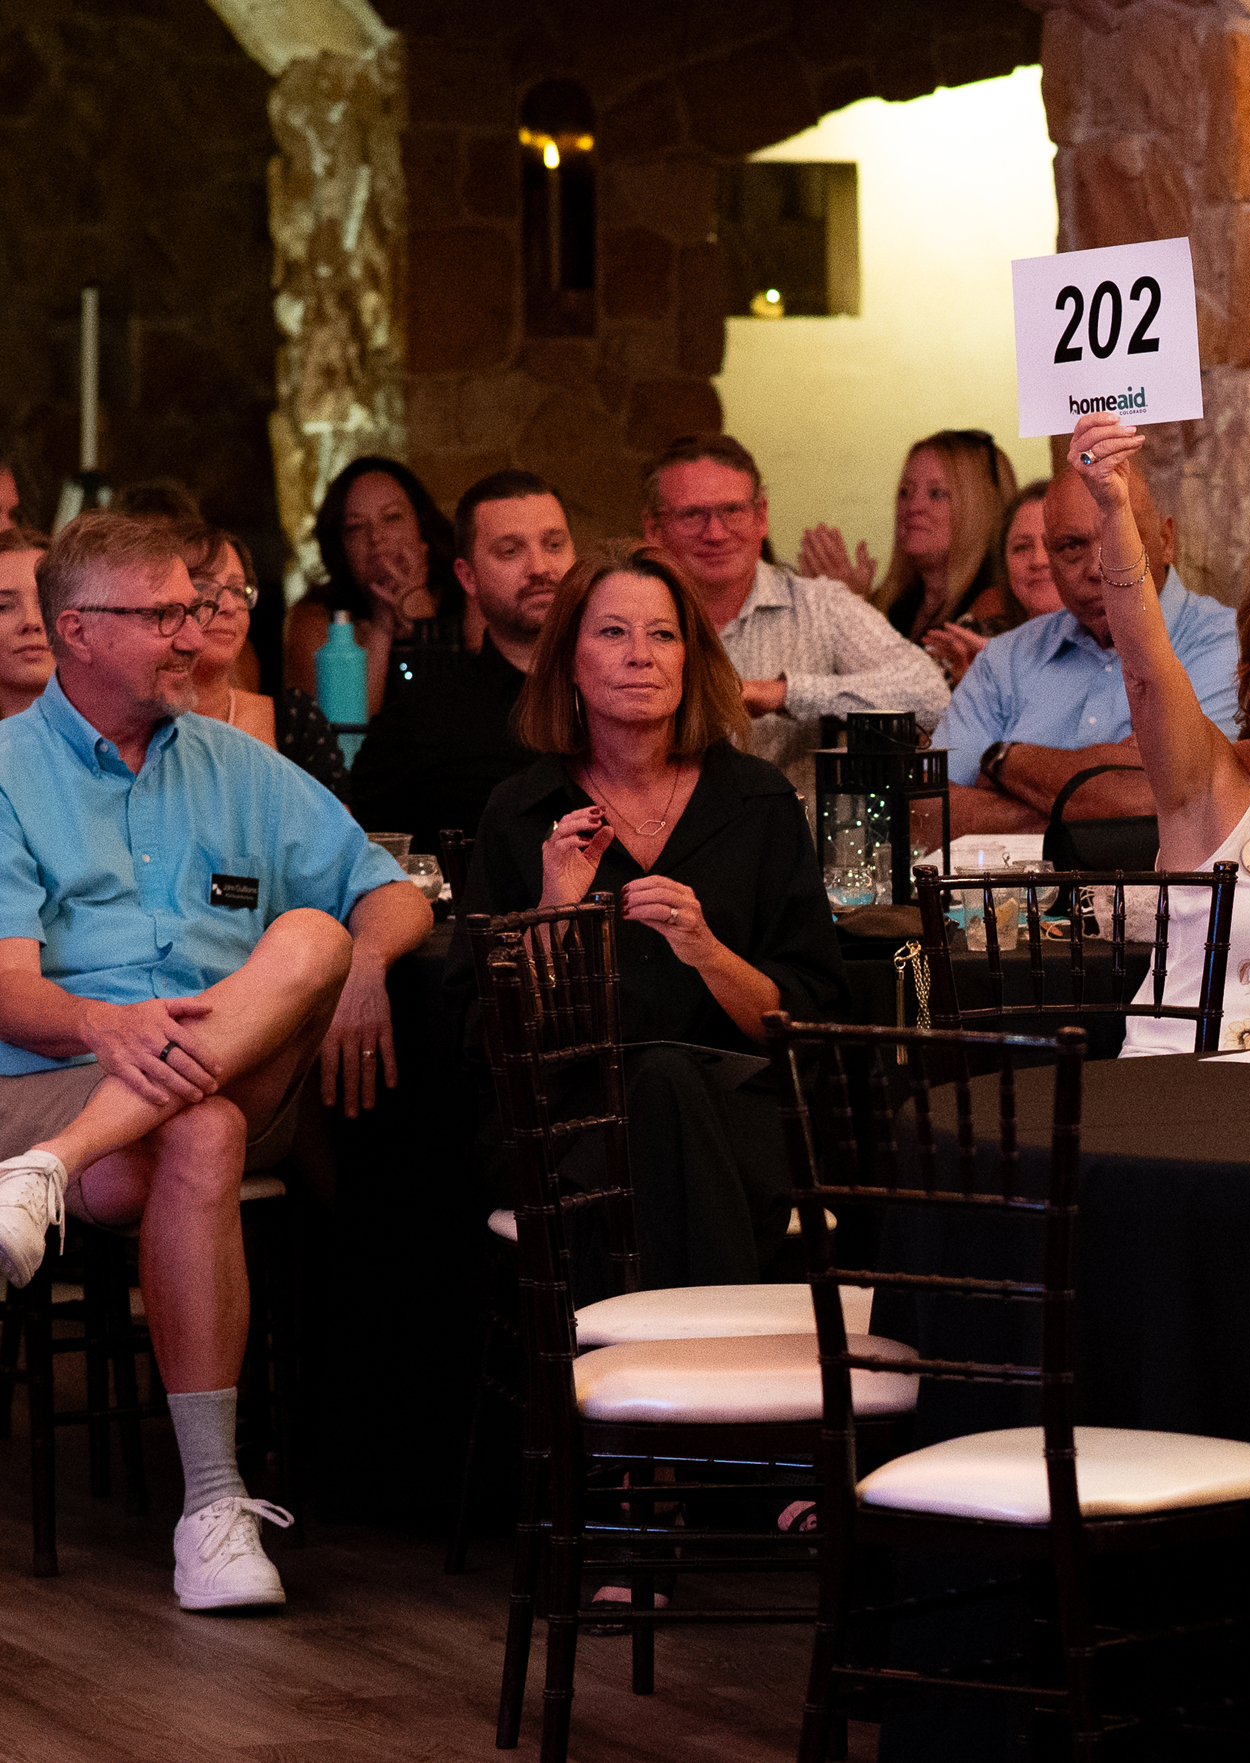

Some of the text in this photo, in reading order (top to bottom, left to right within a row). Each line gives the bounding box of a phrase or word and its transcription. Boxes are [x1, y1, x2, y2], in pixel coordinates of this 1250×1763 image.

[1053, 275, 1161, 364] 202
[1069, 386, 1146, 415] homeaid
[1119, 408, 1147, 416] COLORADO
